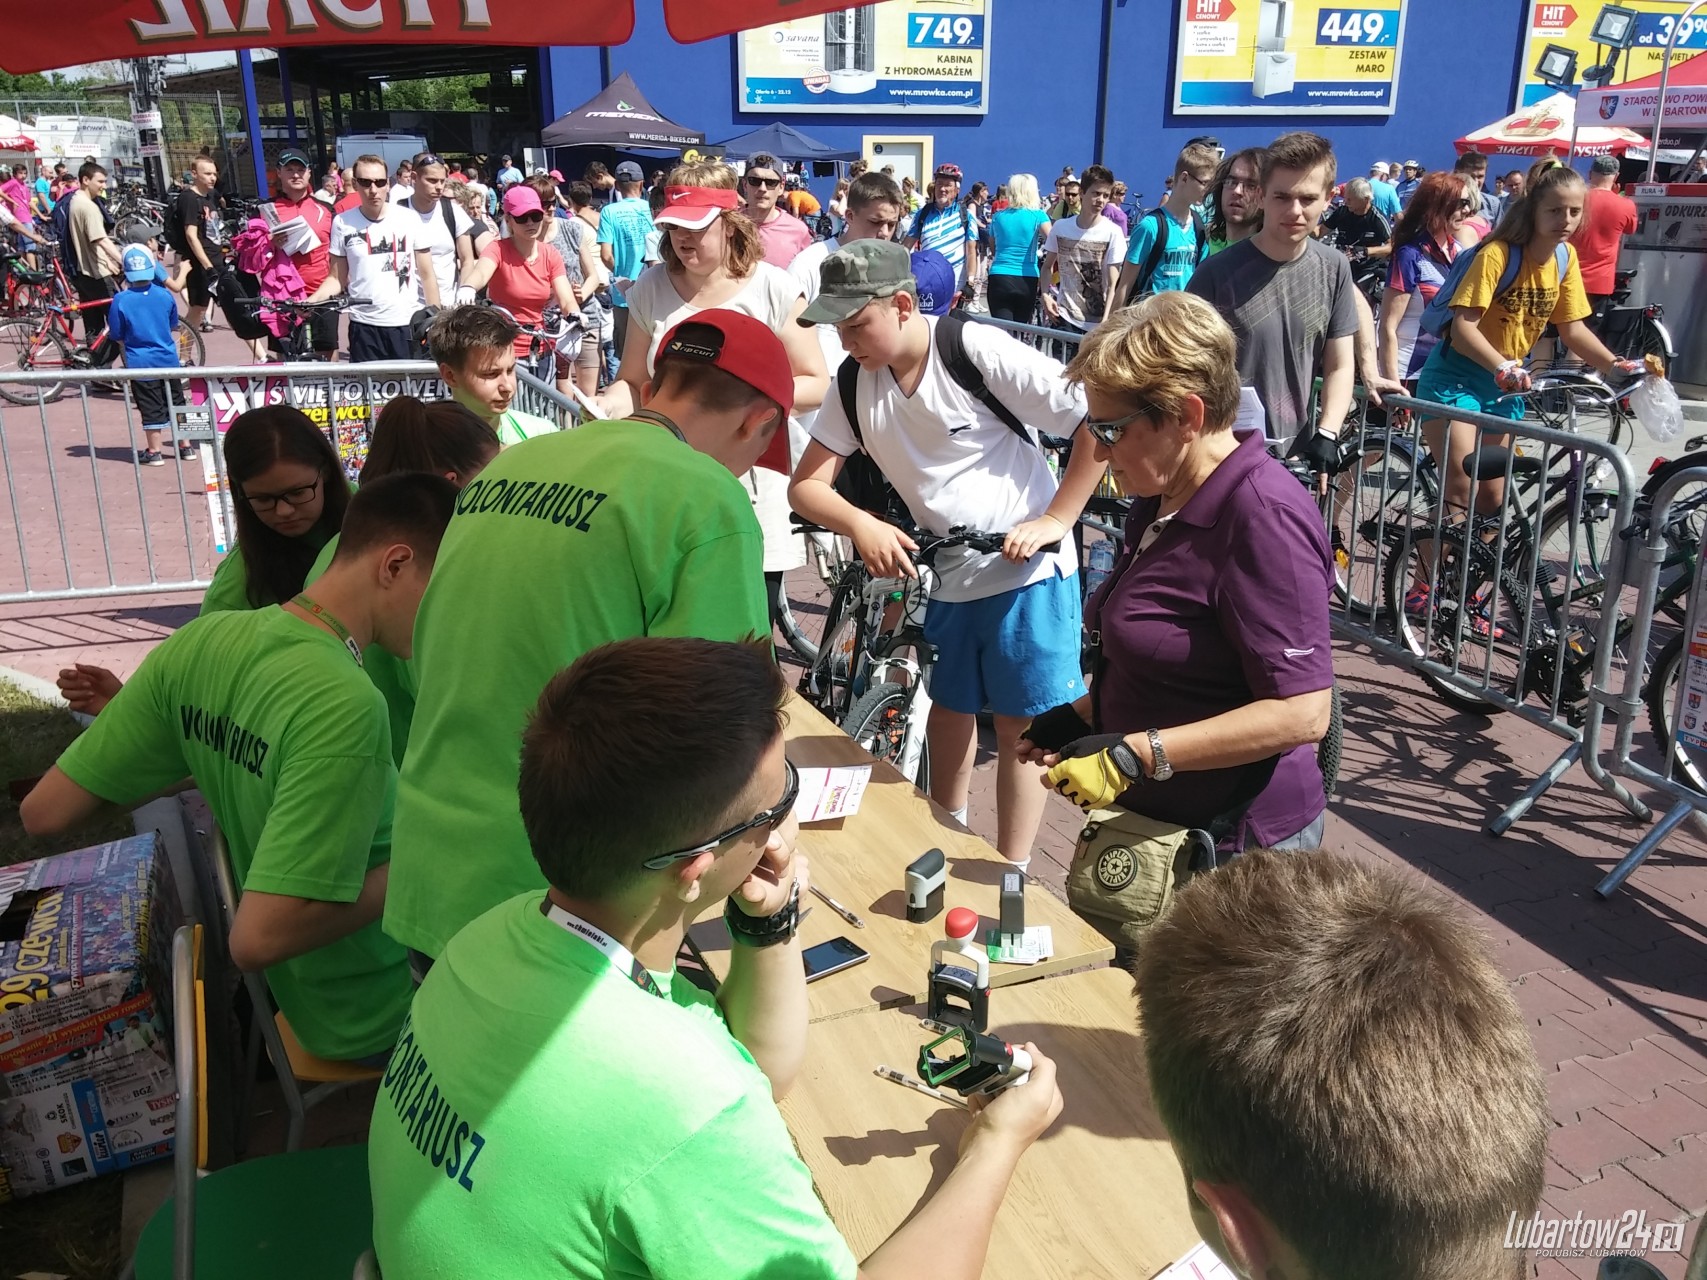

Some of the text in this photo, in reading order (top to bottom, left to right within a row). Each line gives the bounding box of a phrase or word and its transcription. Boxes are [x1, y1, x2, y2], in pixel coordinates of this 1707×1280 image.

[1196, 0, 1221, 13] HIT
[1542, 6, 1566, 20] HIT
[786, 34, 820, 43] savana
[1638, 31, 1654, 44] od
[937, 54, 973, 64] KABINA
[1348, 49, 1387, 60] ZESTAW
[885, 65, 973, 77] Z HYDROMASAŻEM
[1355, 63, 1385, 73] MARO
[889, 88, 973, 98] www.mrowka.com.pl
[1308, 88, 1384, 98] www.mrowka.com.pl
[1623, 95, 1680, 106] STAROSWO
[585, 111, 664, 122] MERIDA
[1642, 106, 1707, 116] W LBARTOW
[629, 132, 700, 144] WWW.MERIDA-BIKES.COM
[1664, 205, 1707, 217] ODKURZ
[455, 477, 608, 533] OLONTARIUSZ
[1104, 850, 1131, 868] KIPLING
[1100, 866, 1127, 884] KIPLING
[61, 1018, 98, 1037] wysokiej
[384, 1015, 486, 1193] ONTARIUSZ
[56, 1103, 68, 1124] SKOK
